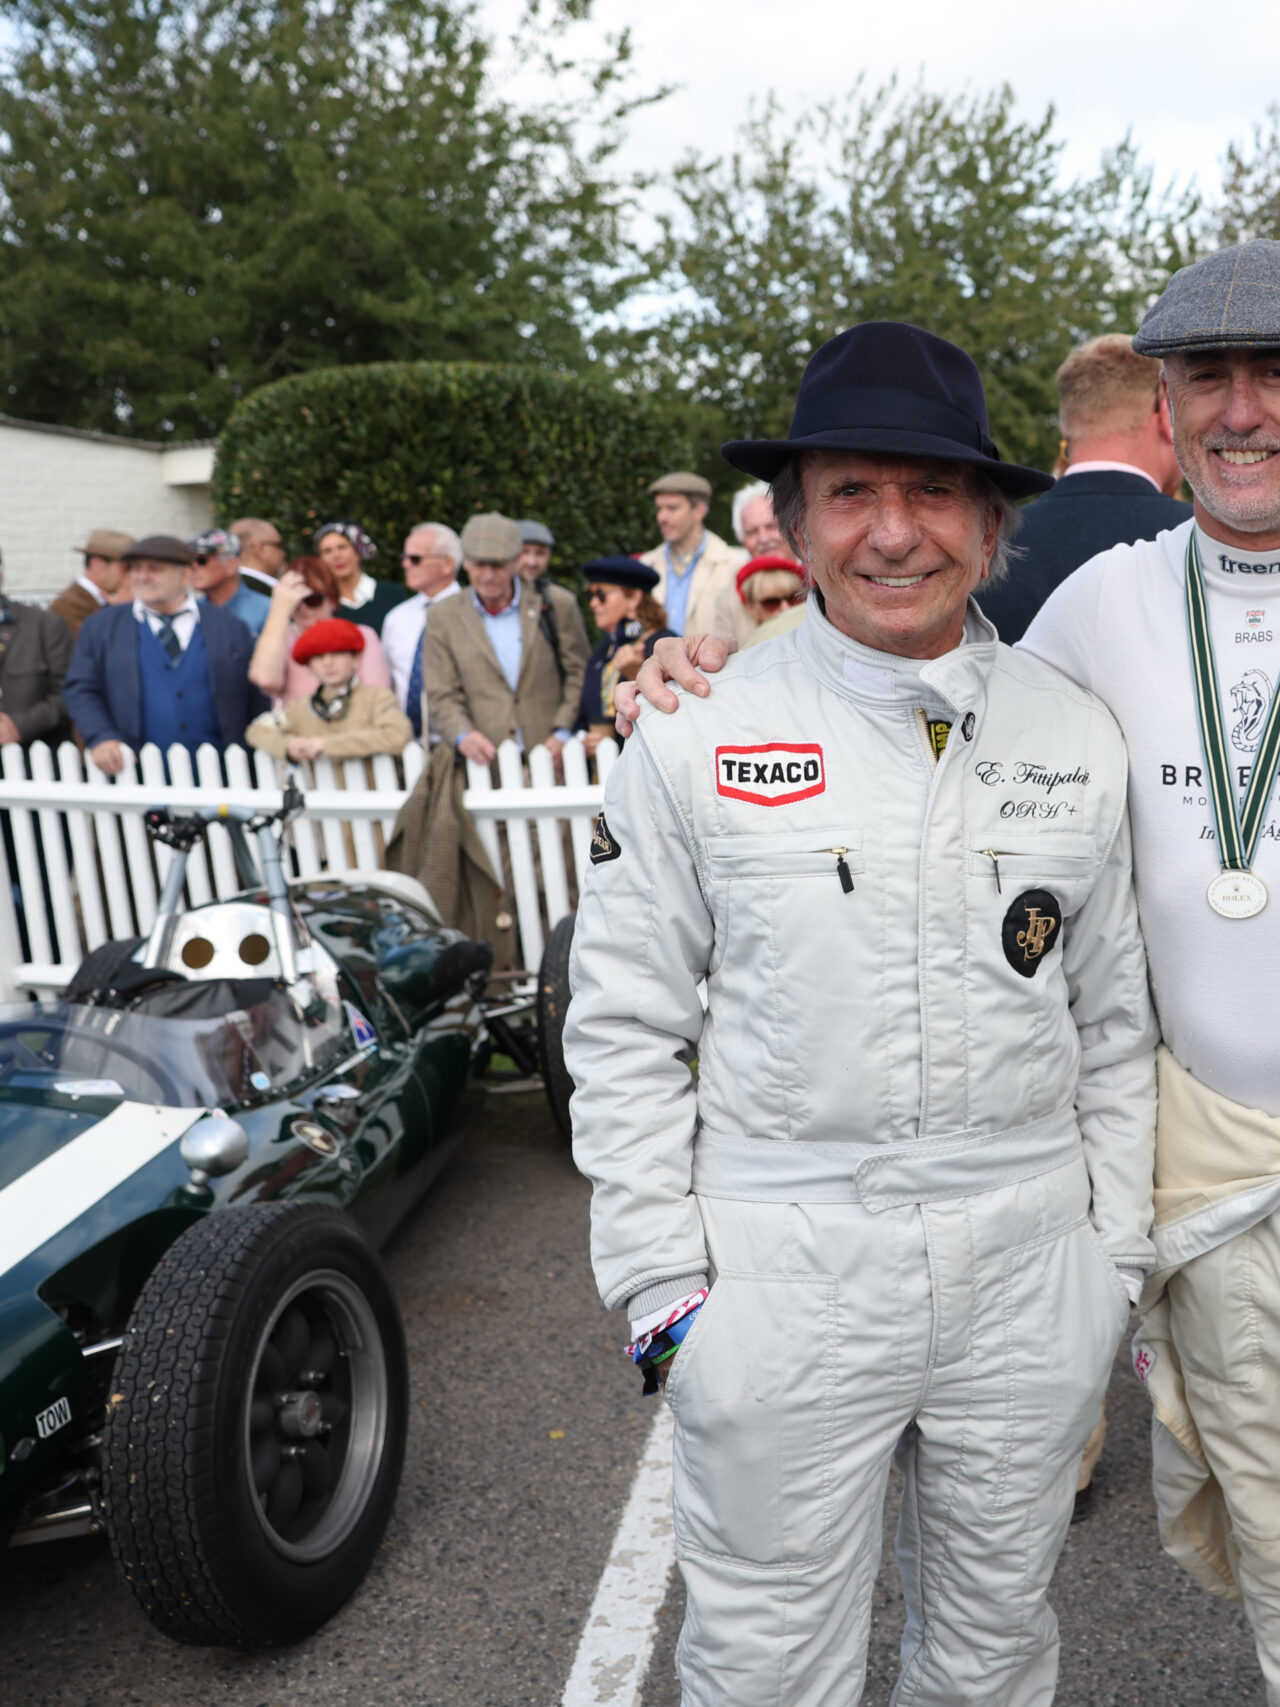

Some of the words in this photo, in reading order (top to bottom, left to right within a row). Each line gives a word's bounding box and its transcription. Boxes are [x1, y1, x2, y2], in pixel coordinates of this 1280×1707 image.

[1235, 630, 1273, 644] BRABS
[721, 759, 819, 784] TEXACO
[975, 761, 1005, 786] E.
[38, 1399, 69, 1437] TOW
